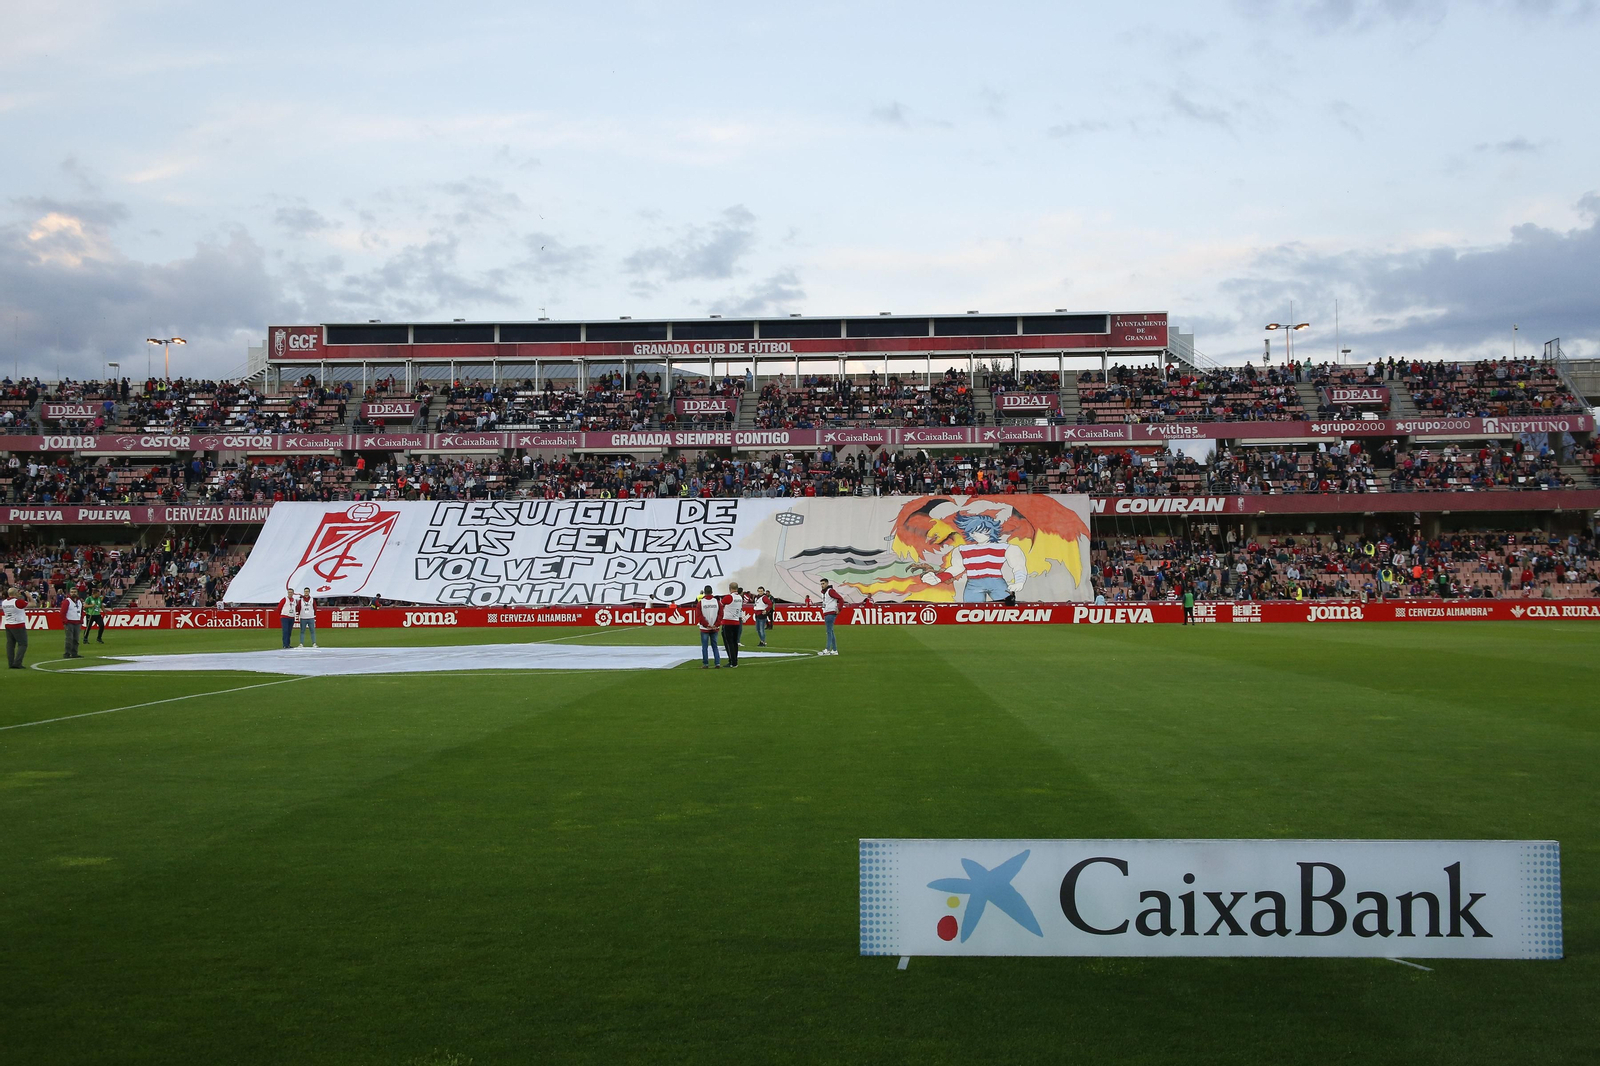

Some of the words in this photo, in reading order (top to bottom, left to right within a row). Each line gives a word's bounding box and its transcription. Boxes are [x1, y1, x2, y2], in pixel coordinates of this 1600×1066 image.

[289, 334, 318, 349] GCF
[633, 343, 690, 355] GRANADA
[693, 343, 726, 354] CLUB
[729, 342, 745, 354] DE
[748, 341, 794, 353] FÚTBOL
[1333, 389, 1382, 400] IDEAL
[683, 400, 728, 411] IDEAL
[1003, 396, 1051, 406] IDEAL
[48, 405, 96, 416] IDEAL
[368, 403, 414, 413] IDEAL
[1159, 424, 1198, 434] vithas
[1321, 422, 1386, 434] grupo2000
[1405, 420, 1471, 433] grupo2000
[1501, 421, 1569, 433] NEPTUNO
[611, 434, 672, 446] GRANADA
[675, 433, 731, 445] SIEMPRE
[735, 432, 789, 444] CONTIGO
[838, 432, 883, 442] CaixaBank
[917, 431, 963, 441] CaixaBank
[997, 430, 1043, 440] CaixaBank
[1077, 429, 1124, 439] CaixaBank
[140, 436, 190, 447] CASTOR
[223, 436, 272, 447] CASTOR
[299, 437, 344, 447] CaixaBank
[377, 437, 422, 447] CaixaBank
[454, 437, 499, 446] CaixaBank
[532, 436, 577, 446] CaixaBank
[1115, 498, 1226, 513] COVIRAN
[9, 509, 63, 521] PULEVA
[78, 508, 131, 521] PULEVA
[165, 508, 224, 521] CERVEZAS
[228, 507, 272, 521] ALHAM
[676, 498, 738, 525] DE
[418, 529, 516, 556] LAS
[544, 527, 734, 554] CENIZAS
[787, 611, 824, 622] RURA
[850, 607, 918, 625] Allianz
[956, 609, 1053, 622] COVIRAN
[1073, 606, 1154, 624] PULEVA
[1408, 607, 1445, 617] CERVEZAS
[1446, 607, 1488, 616] ALHAMBRA
[1527, 605, 1560, 618] CAJA
[1562, 605, 1600, 617] RURA
[194, 613, 264, 628] CaixaBank
[500, 613, 535, 622] CERVEZAS
[537, 613, 577, 622] ALHAMBRA
[614, 610, 666, 626] LaLiga
[1059, 856, 1493, 938] CaixaBank
